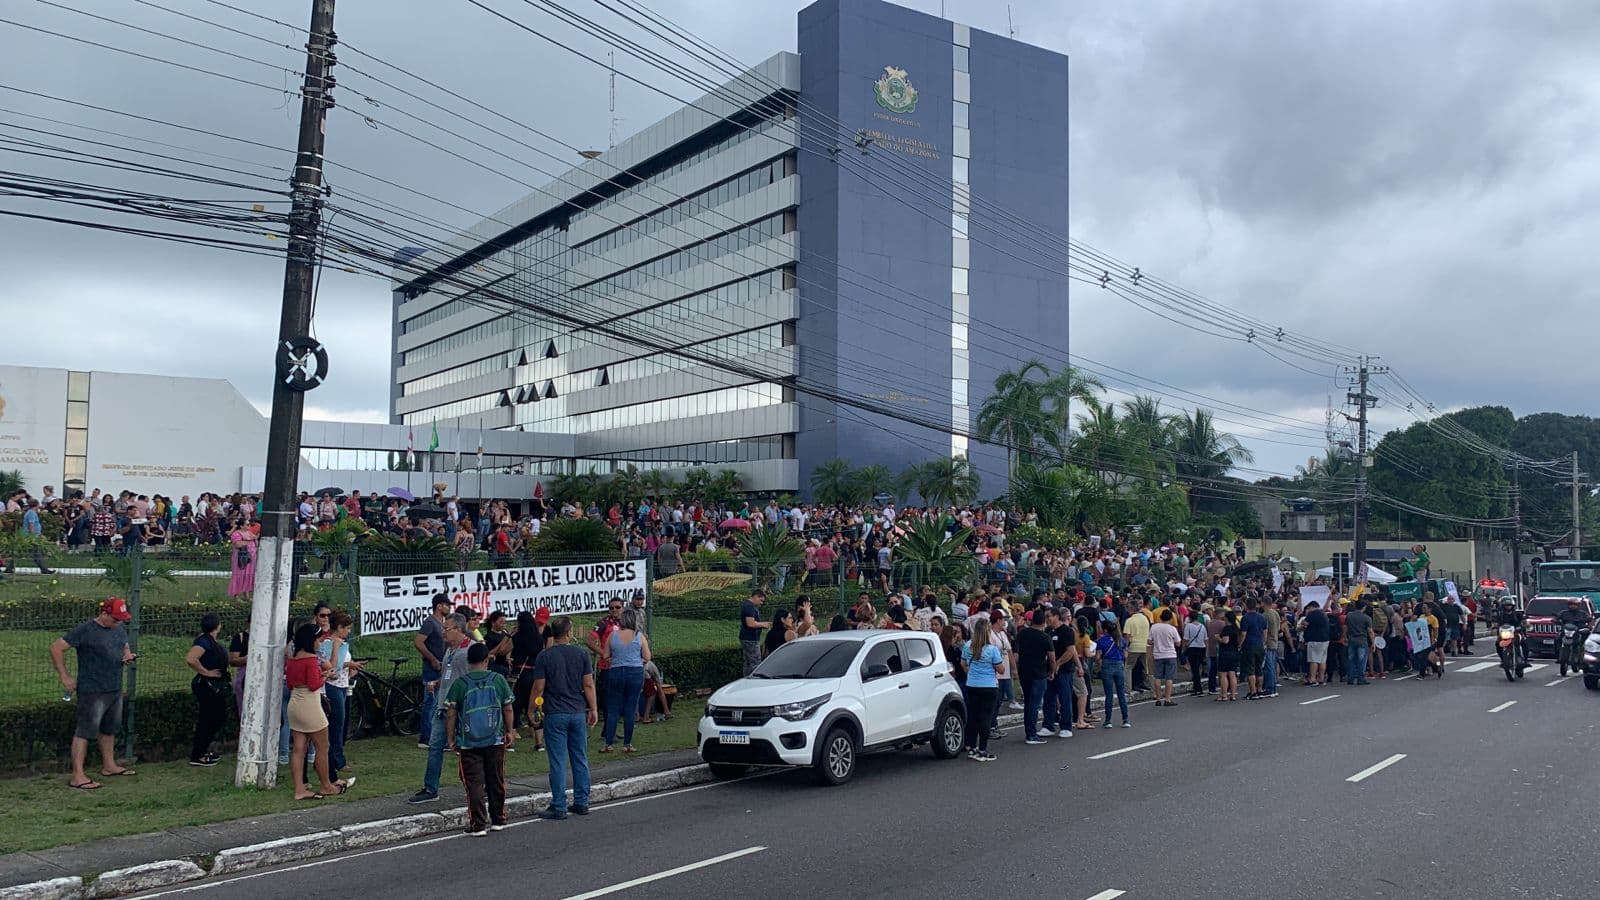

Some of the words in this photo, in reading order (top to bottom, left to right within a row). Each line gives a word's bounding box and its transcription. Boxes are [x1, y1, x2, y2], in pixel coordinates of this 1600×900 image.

[477, 569, 539, 592] MARIA
[541, 567, 562, 587] DE
[566, 562, 636, 585] LOURDES
[583, 590, 597, 611] DA
